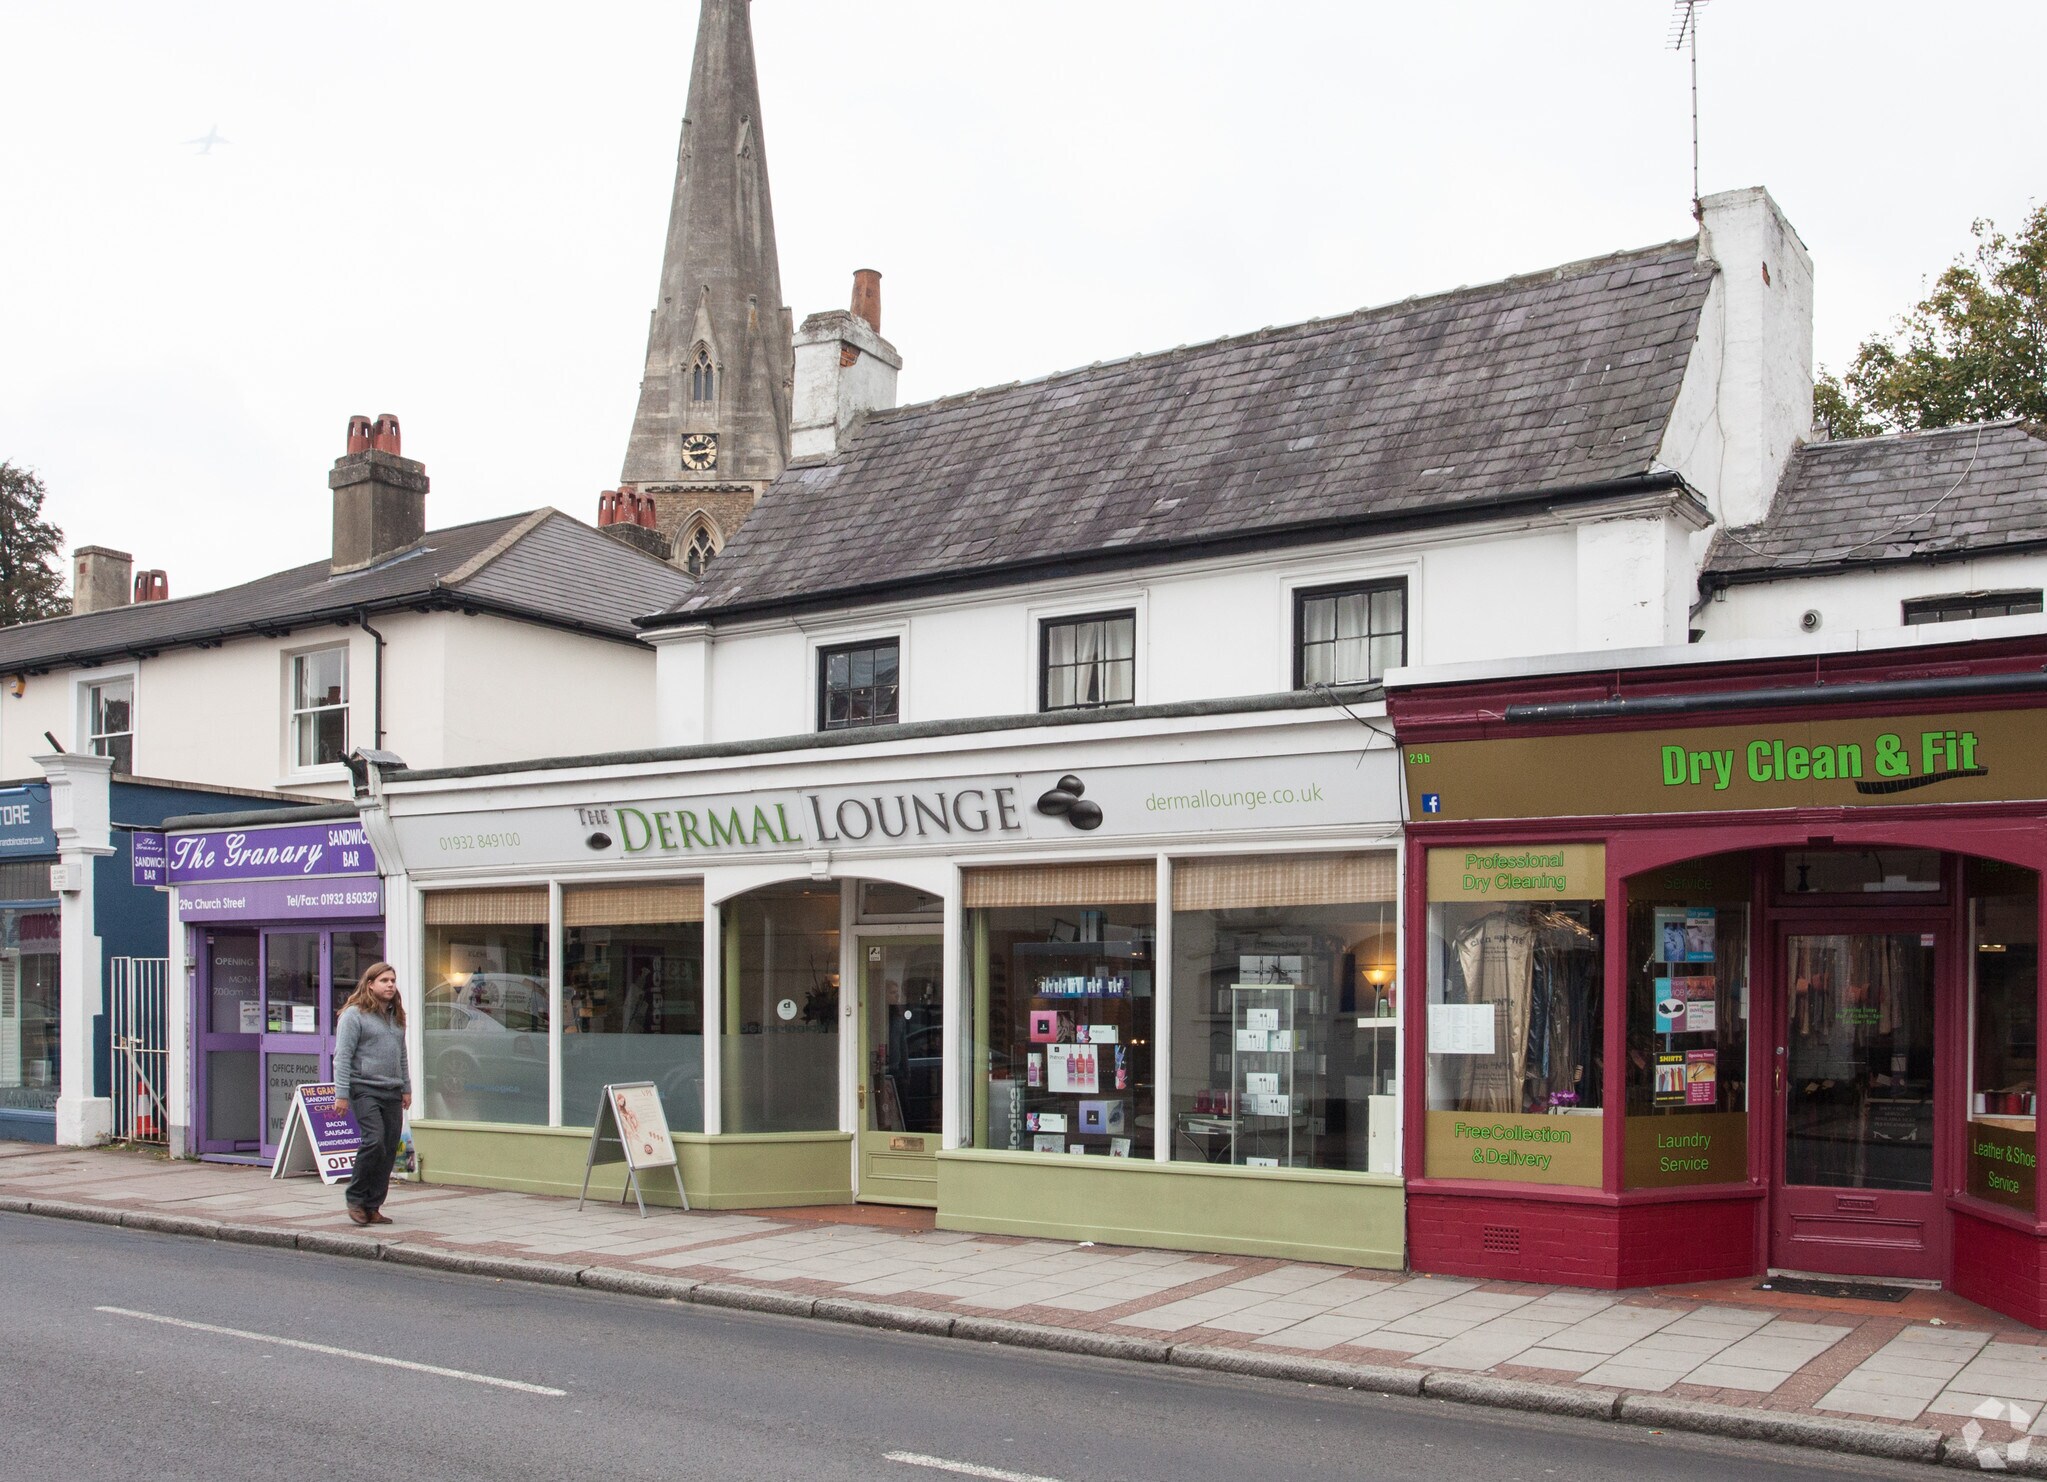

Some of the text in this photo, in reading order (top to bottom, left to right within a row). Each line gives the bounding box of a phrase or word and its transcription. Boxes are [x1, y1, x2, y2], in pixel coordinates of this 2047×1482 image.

[1409, 753, 1431, 765] 29b
[1661, 730, 1980, 790] Dry Clean & Fit
[1145, 782, 1324, 812] dermallounge.co.uk
[614, 802, 802, 853] DERMAL
[806, 786, 1022, 843] LOUNGE
[328, 829, 370, 847] SANDWIC
[439, 831, 521, 851] 01932 849100
[170, 833, 323, 873] The Granary
[342, 850, 360, 867] BAR
[1465, 851, 1564, 869] Professional
[135, 856, 165, 868] SANDWICH
[144, 869, 156, 880] BAR
[1463, 872, 1566, 893] Dry Cleaning
[1664, 873, 1713, 890] Service
[180, 897, 246, 910] 29a Church Street
[287, 891, 378, 907] Tel/Fax: 01932 850329
[215, 957, 254, 967] OPENING
[272, 1064, 318, 1074] OFFICE PHONE
[270, 1078, 279, 1087] OR
[280, 1079, 294, 1088] FAX
[301, 1086, 336, 1097] THE GRAN
[324, 1128, 355, 1137] SAUSAGE
[325, 1120, 348, 1128] BACON
[1454, 1122, 1572, 1143] Free Collection
[1658, 1132, 1712, 1151] Laundry
[1472, 1147, 1552, 1171] & Delivery
[1973, 1138, 2037, 1168] Leather & Shoe
[327, 1155, 357, 1170] OPE
[1660, 1156, 1709, 1172] Service
[1988, 1171, 2020, 1194] Service
